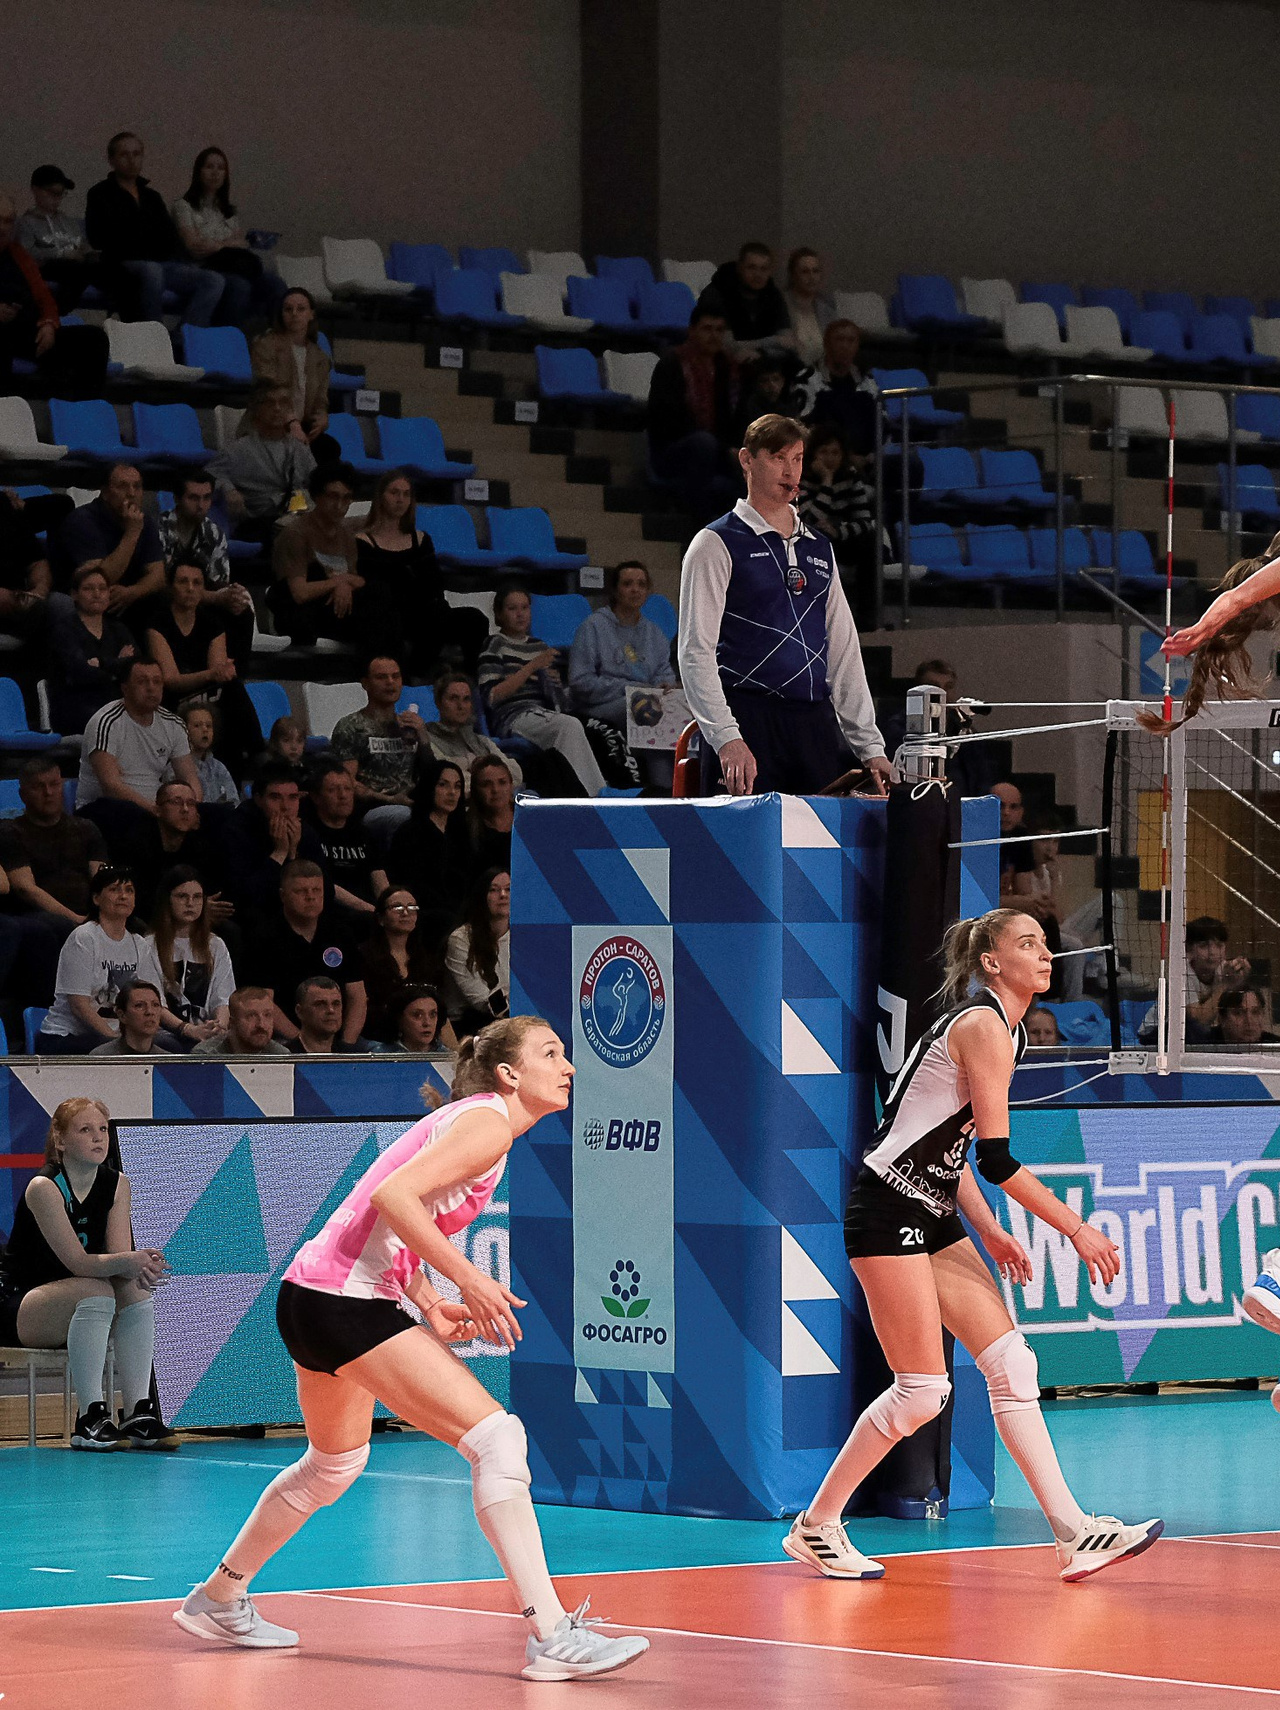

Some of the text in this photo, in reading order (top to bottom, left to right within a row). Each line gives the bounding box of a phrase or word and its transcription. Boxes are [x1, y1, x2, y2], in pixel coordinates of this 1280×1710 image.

[584, 942, 618, 986] ПРОТОН
[625, 942, 661, 990] САРАТОВ
[584, 1018, 661, 1062] Саратовская область
[605, 1118, 662, 1152] ВФВ
[1008, 1183, 1223, 1310] World
[582, 1322, 667, 1345] ФОСАГРО
[219, 1562, 245, 1581] rrea
